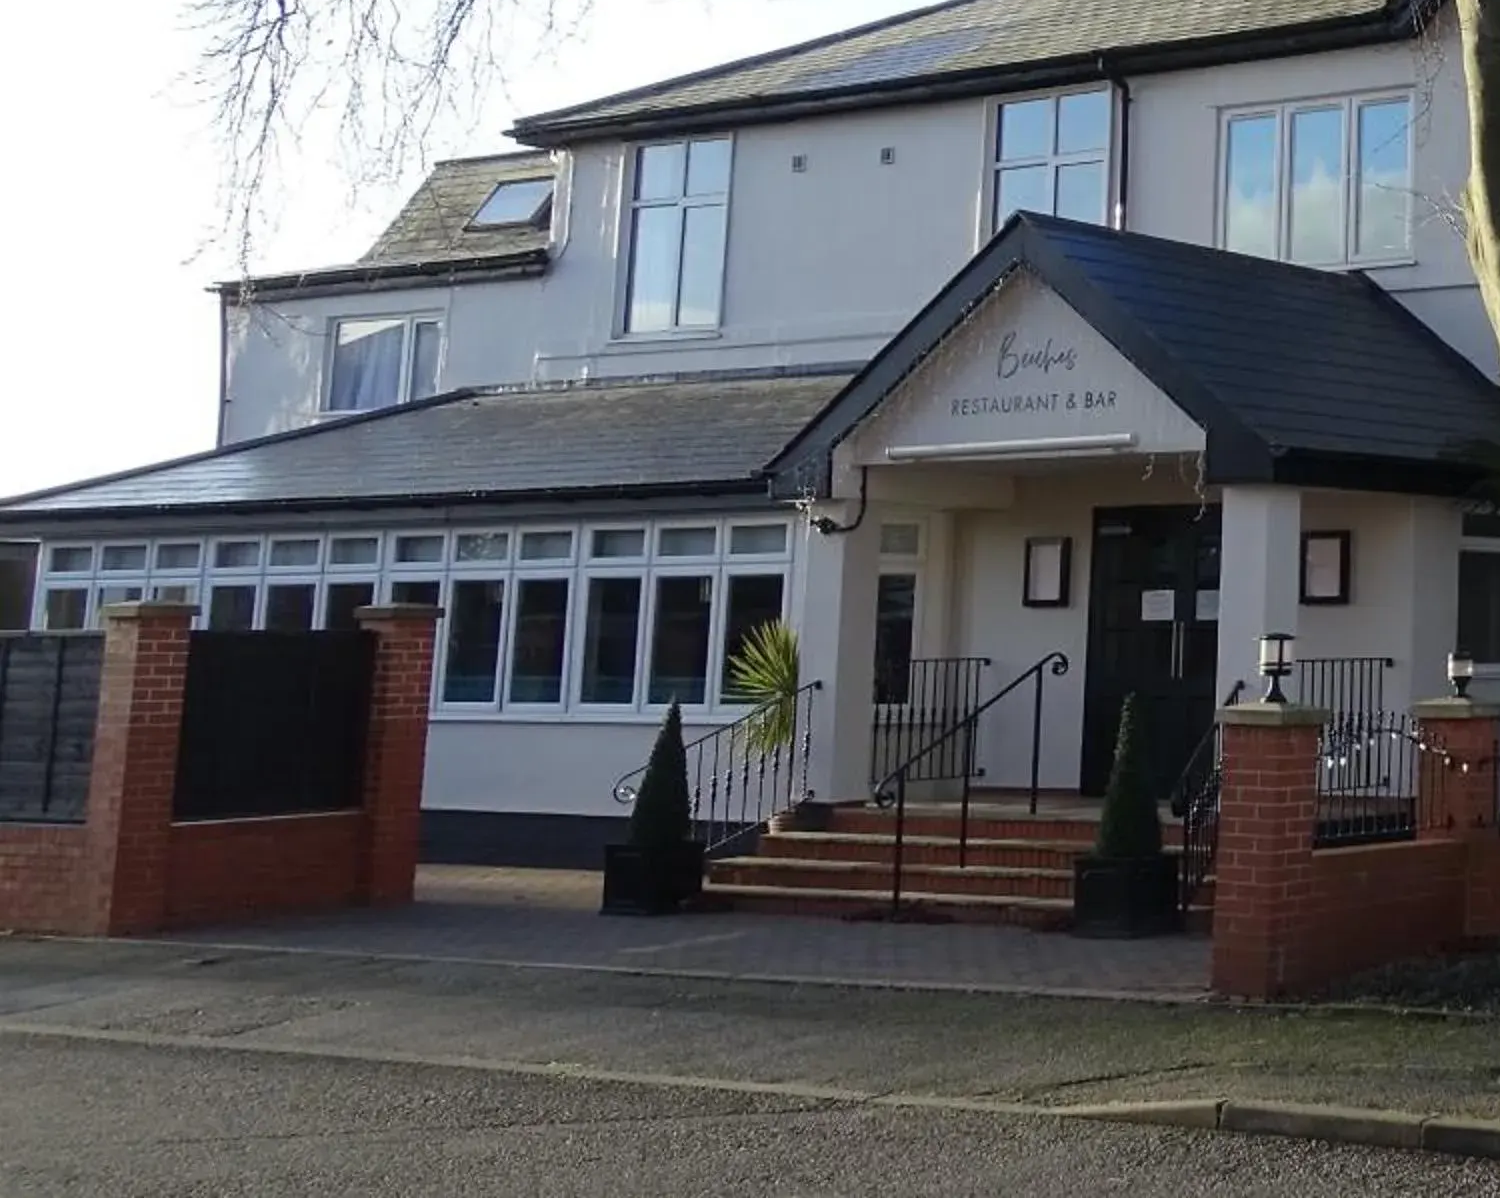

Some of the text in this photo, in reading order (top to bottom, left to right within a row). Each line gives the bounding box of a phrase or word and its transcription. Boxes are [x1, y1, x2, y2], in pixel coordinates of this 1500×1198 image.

[997, 331, 1077, 378] Beeches
[951, 391, 1117, 416] RESTAURANT & BAR
